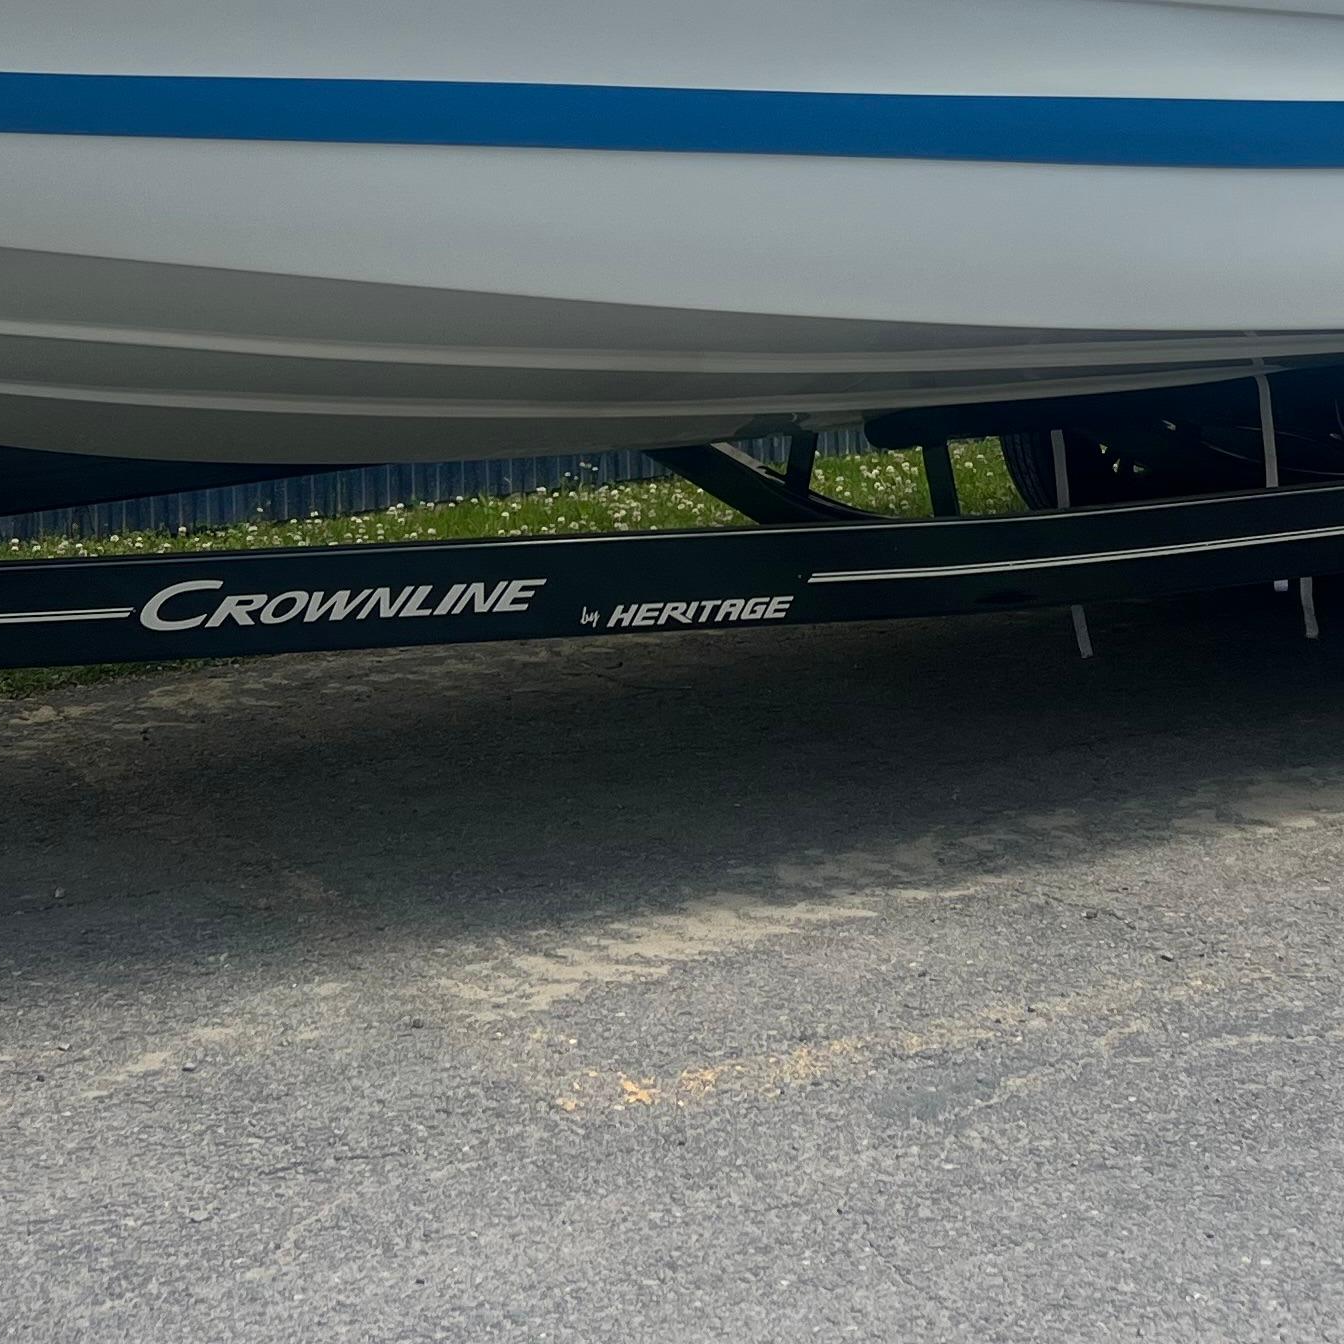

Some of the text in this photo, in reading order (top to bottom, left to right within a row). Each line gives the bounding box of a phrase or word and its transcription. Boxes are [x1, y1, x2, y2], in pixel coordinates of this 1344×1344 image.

[139, 578, 795, 632] CROWNLINE by HERITAGE
